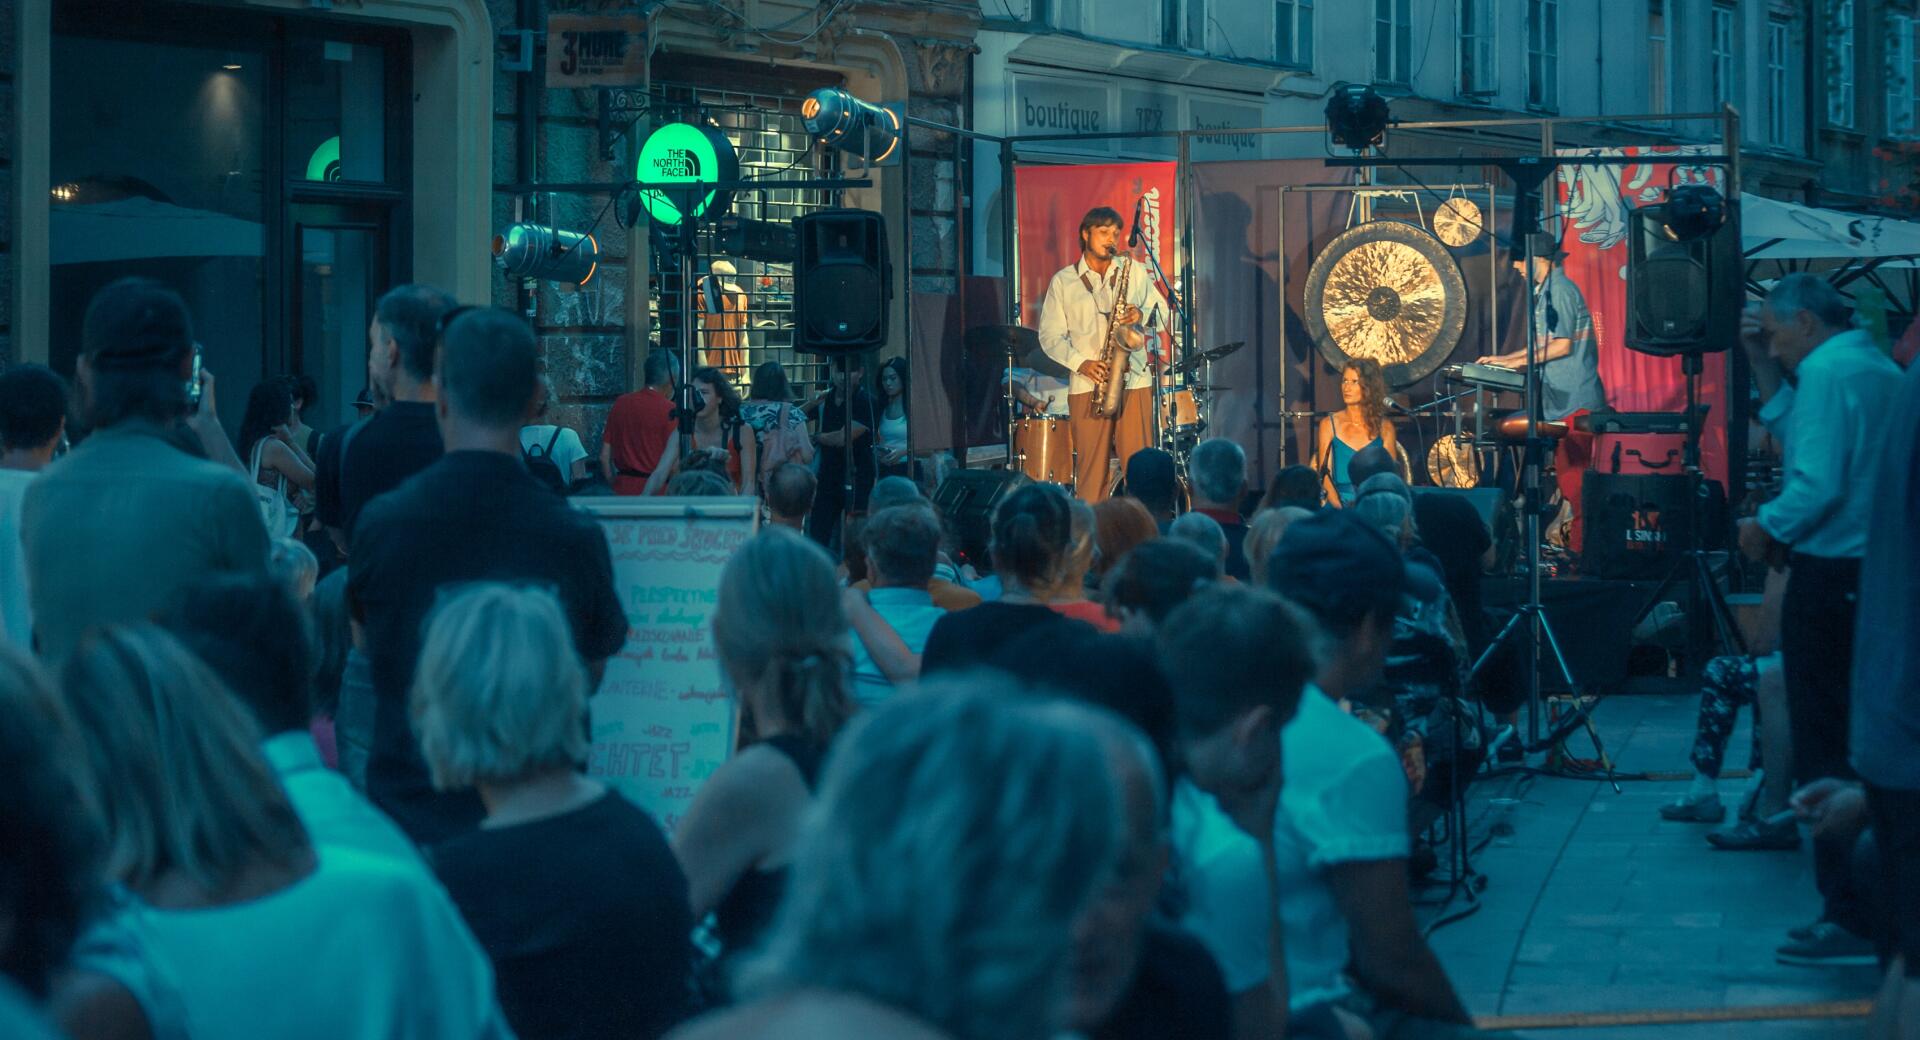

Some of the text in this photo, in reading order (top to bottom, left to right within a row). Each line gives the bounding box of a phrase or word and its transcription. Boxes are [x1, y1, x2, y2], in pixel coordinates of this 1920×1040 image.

[1024, 97, 1100, 134] boutique
[667, 148, 685, 158] THE
[652, 158, 685, 168] NORTH
[661, 167, 684, 177] FACE
